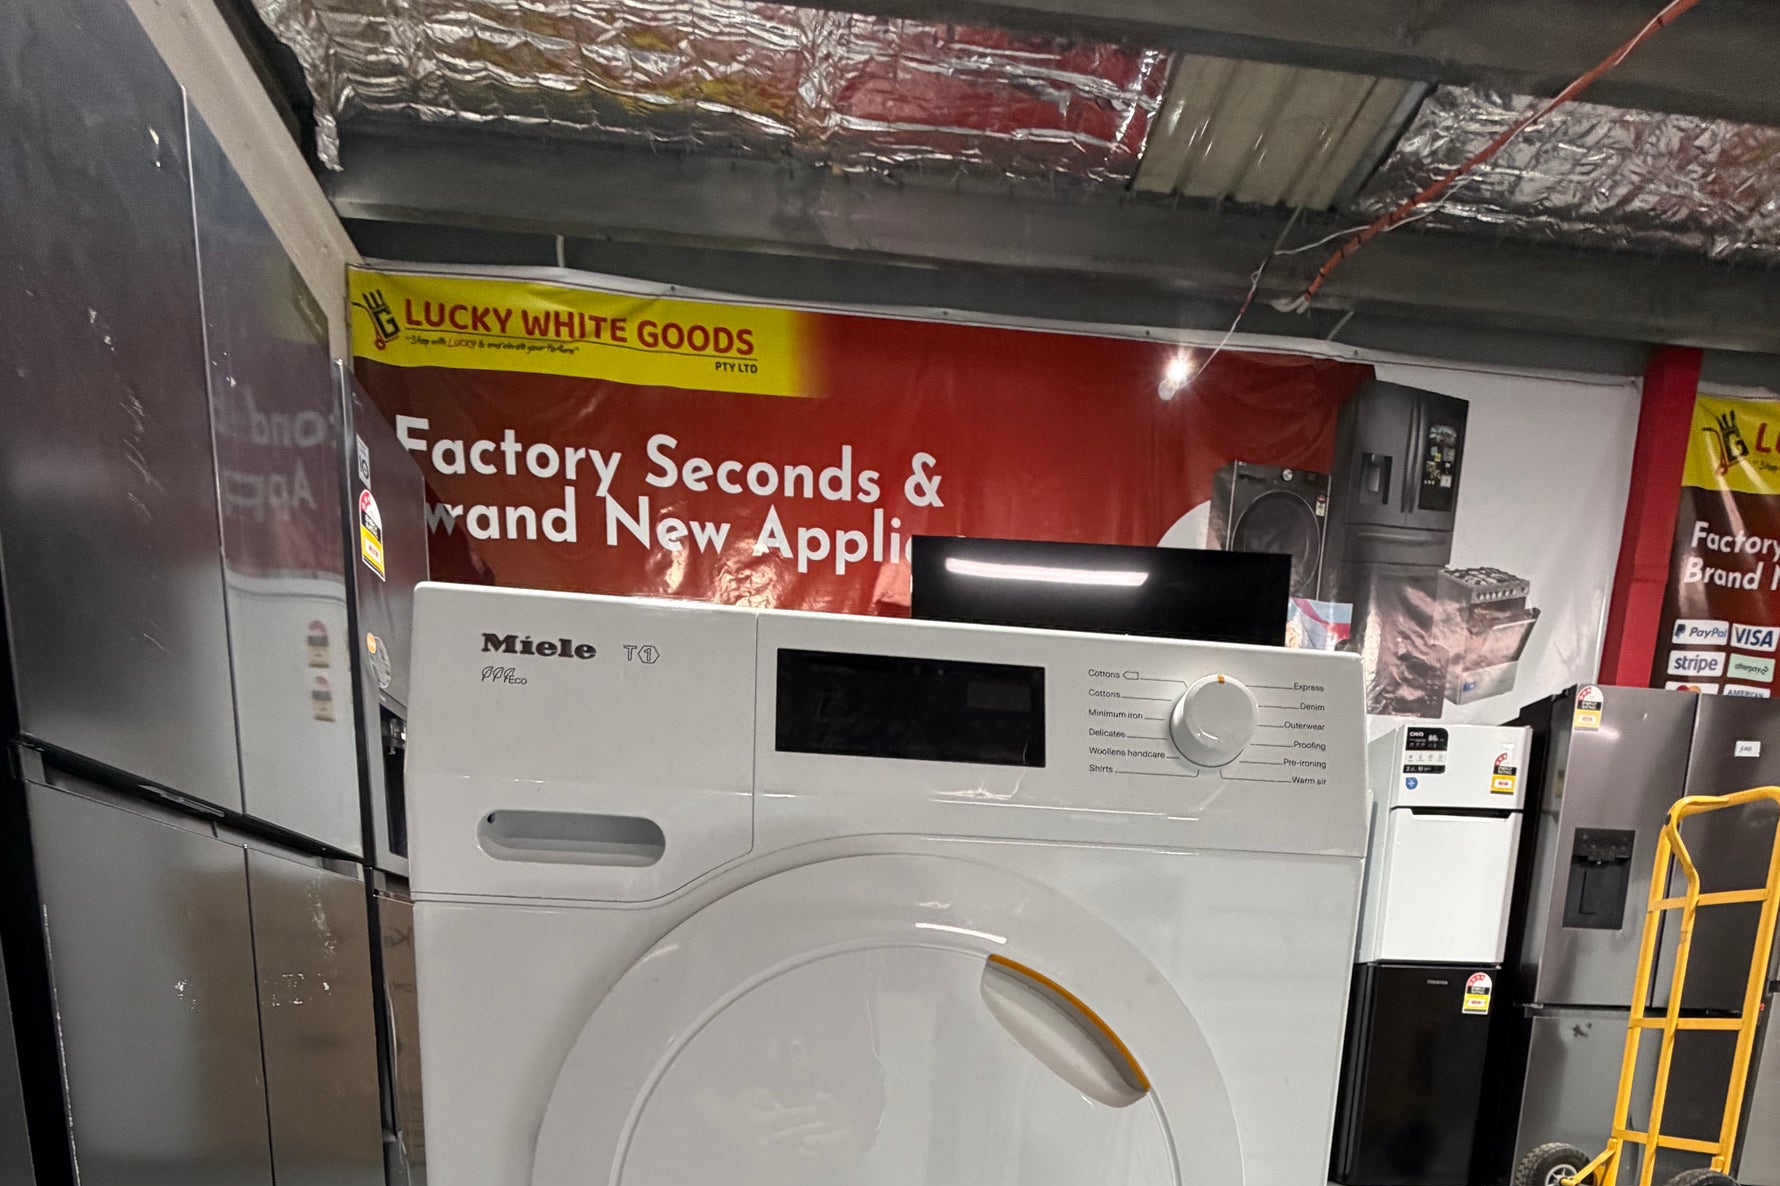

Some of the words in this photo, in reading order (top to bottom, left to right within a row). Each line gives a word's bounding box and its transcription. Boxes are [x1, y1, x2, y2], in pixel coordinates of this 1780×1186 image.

[405, 299, 512, 333] LUCKY
[521, 308, 627, 343] WHITE
[637, 319, 754, 356] GOODS
[715, 361, 736, 372] PTY
[738, 363, 758, 374] LTD
[396, 414, 622, 497] Factory
[645, 434, 880, 503] Seconds
[904, 452, 944, 508] &
[424, 485, 577, 543] rand
[605, 492, 731, 555] New
[752, 504, 912, 575] Appli
[1684, 556, 1764, 590] Brand
[1689, 626, 1727, 639] PayPal
[1734, 627, 1773, 648] VISA
[481, 633, 597, 660] Miele
[1674, 654, 1718, 674] stripe
[1088, 669, 1120, 679] Cottons
[1089, 688, 1121, 698] Cottons
[1293, 683, 1324, 693] Express
[1300, 702, 1325, 712] Denim
[1089, 709, 1126, 719] Minimum
[1127, 712, 1143, 720] iron
[1283, 721, 1325, 731] Outerwear
[1088, 728, 1126, 738] Delicates
[1293, 741, 1326, 752] Proofing
[1089, 747, 1126, 757] Woollens
[1127, 749, 1166, 759] handcare
[1089, 764, 1113, 774] Shirts
[1283, 758, 1327, 770] Pre-ironing
[1291, 775, 1316, 785] Warm
[1316, 778, 1327, 786] air
